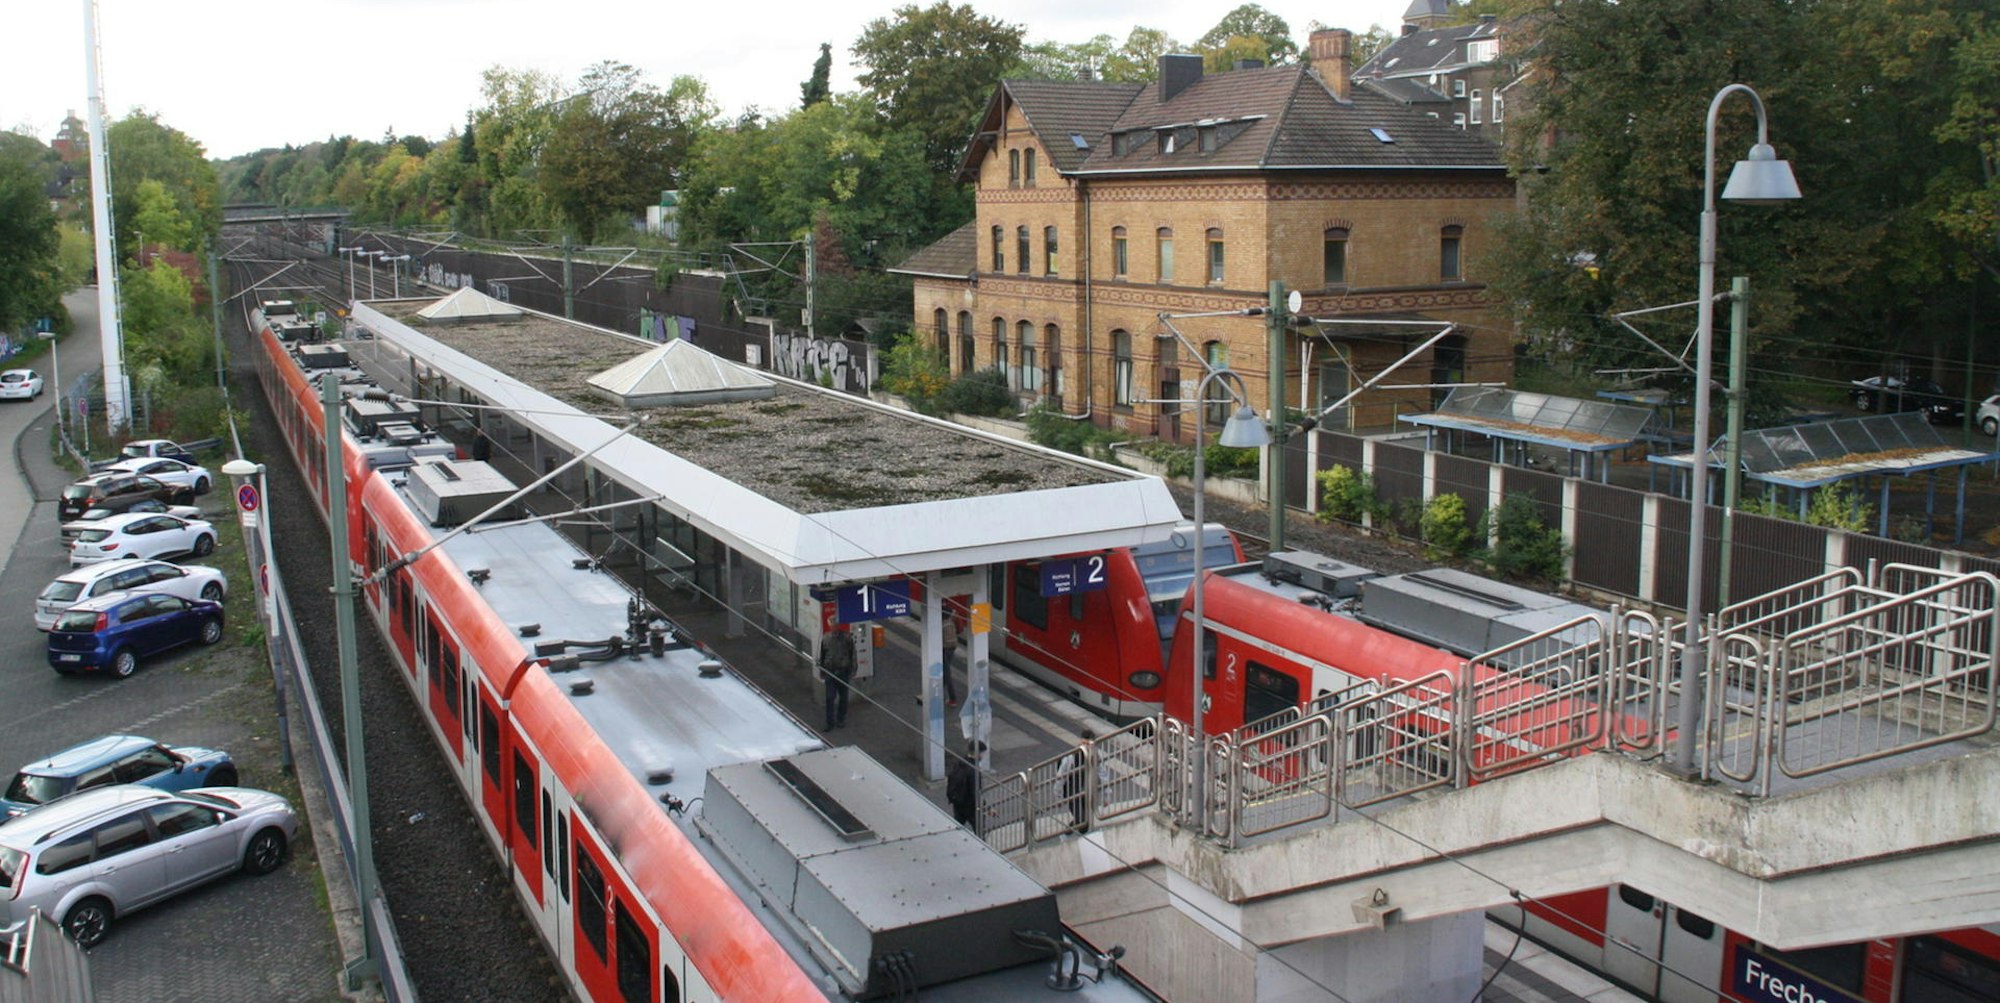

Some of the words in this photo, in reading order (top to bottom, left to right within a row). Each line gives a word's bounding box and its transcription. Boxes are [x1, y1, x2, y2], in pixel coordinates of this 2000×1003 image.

[1088, 556, 1104, 583] 2
[857, 584, 869, 613] 1
[1226, 653, 1236, 673] 2
[607, 885, 614, 913] 2
[1746, 958, 1827, 1003] Frech
